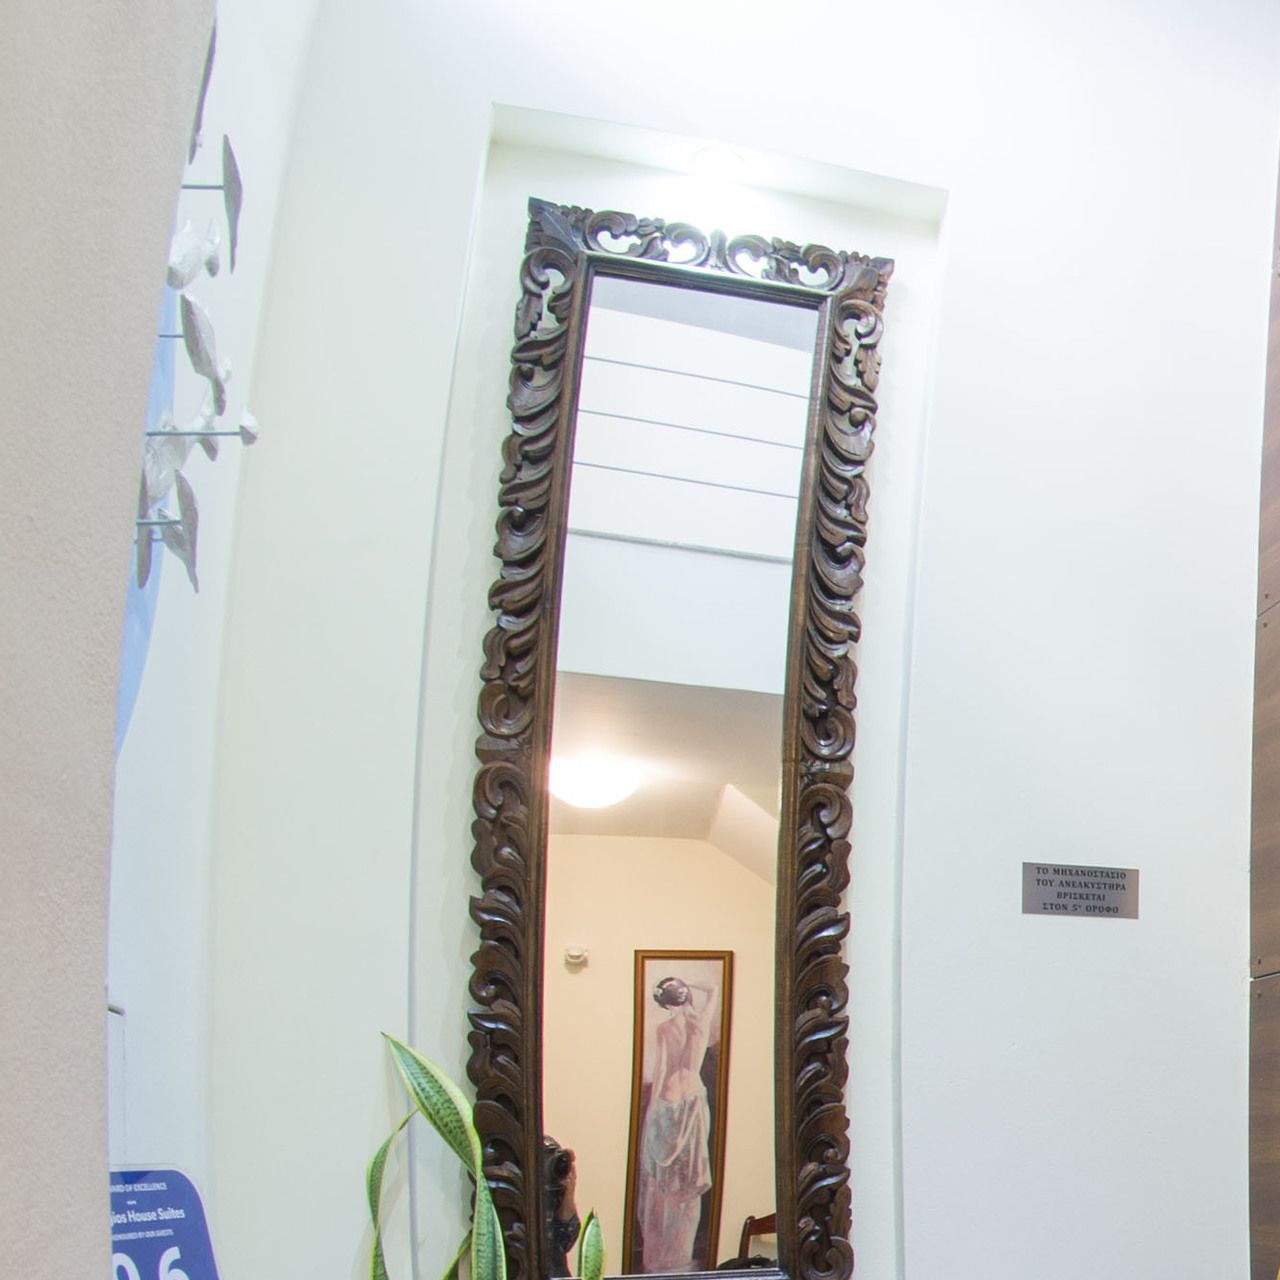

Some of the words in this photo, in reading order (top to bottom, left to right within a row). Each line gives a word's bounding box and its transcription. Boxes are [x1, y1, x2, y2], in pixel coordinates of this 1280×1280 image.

[1035, 866, 1049, 875] ΤΟ
[1053, 867, 1127, 879] ΜΗΧΑΝΟΣΤΑΣΙΟ
[1035, 878, 1055, 887] ΤΟΥ
[1058, 880, 1127, 891] ΑΝΕΛΚΥΣΤΗΡΑ
[1056, 891, 1106, 902] ΒΡΙΣΚΕΤΑΙ
[1042, 902, 1068, 911] ΣΤΟΝ
[1086, 904, 1119, 914] ΟΡΟΦΟ
[126, 1209, 157, 1223] House
[157, 1207, 185, 1220] Suites
